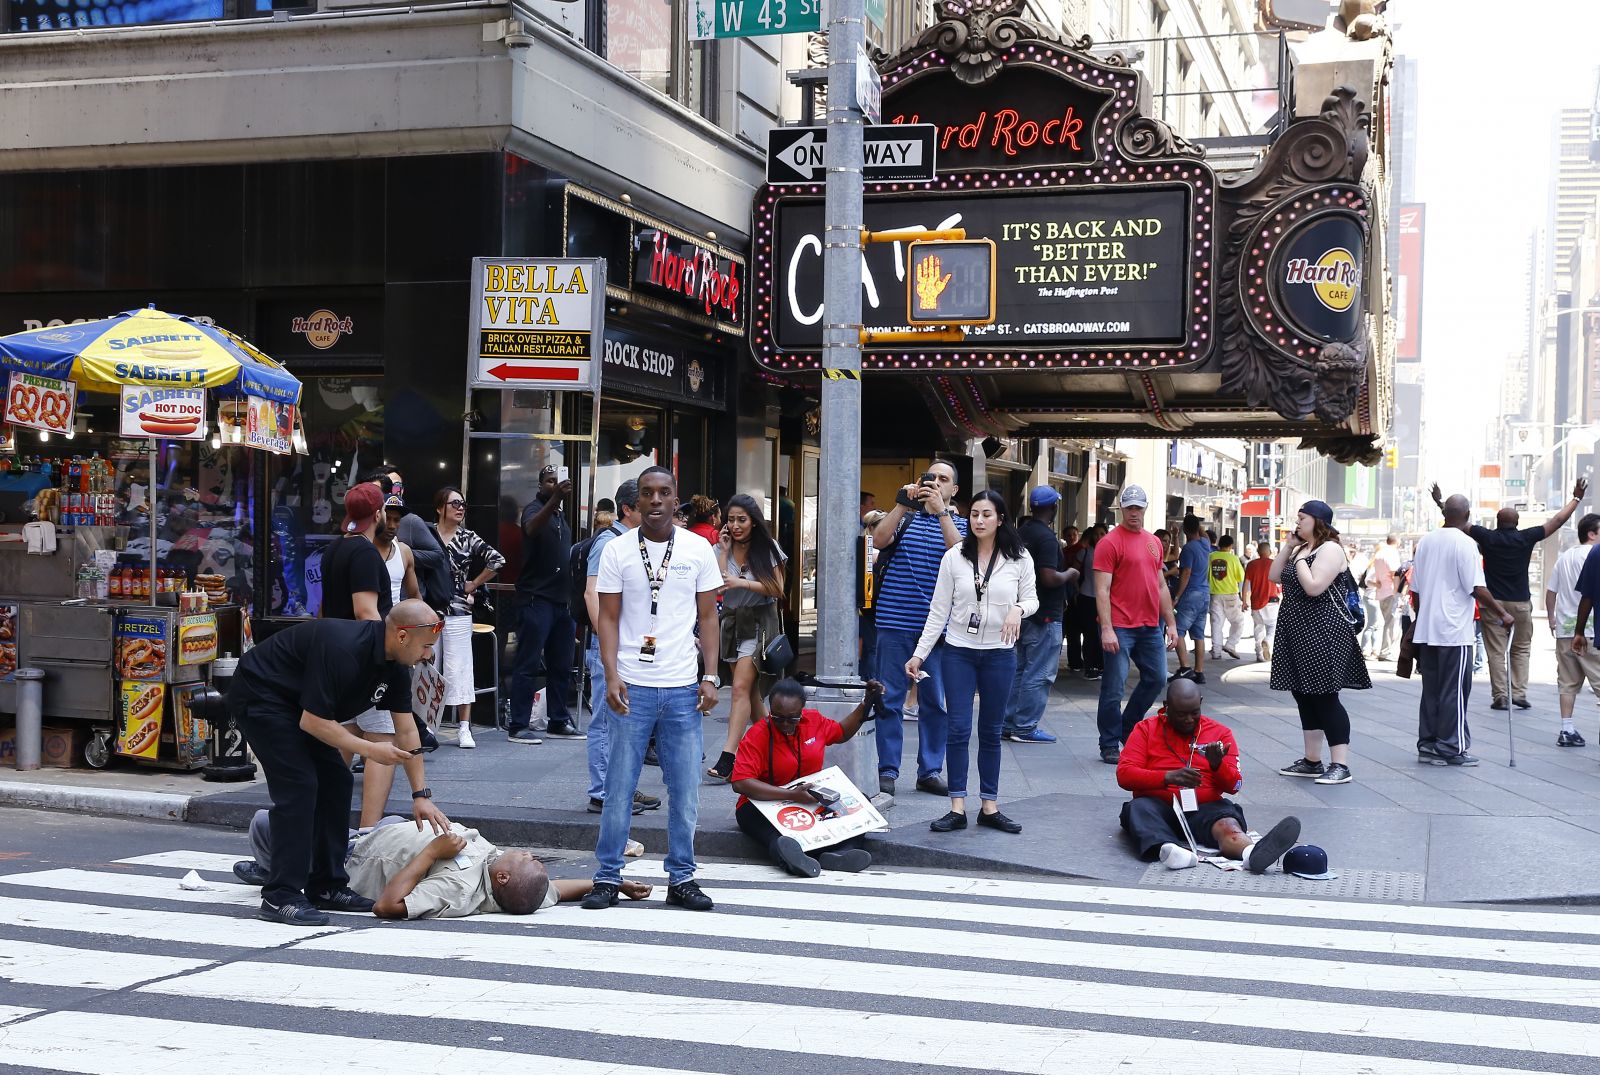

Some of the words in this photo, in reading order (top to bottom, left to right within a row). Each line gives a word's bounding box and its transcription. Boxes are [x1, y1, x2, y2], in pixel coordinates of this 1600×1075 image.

[722, 1, 744, 32] W
[757, 0, 787, 29] 43
[800, 0, 819, 15] St
[991, 107, 1083, 155] Rock
[793, 145, 824, 166] ON
[864, 143, 912, 164] WAY
[1002, 222, 1041, 241] IT’S
[1046, 220, 1106, 240] BACK
[1111, 218, 1162, 237] AND
[1033, 242, 1126, 261] “BETTER
[485, 265, 588, 294] BELLA
[651, 230, 700, 297] Hard
[699, 249, 739, 322] Rock
[1014, 265, 1079, 284] THAN
[1083, 262, 1158, 281] EVER!”
[1286, 258, 1340, 284] Hard
[1038, 287, 1053, 297] The
[1053, 286, 1099, 299] Huffington
[1100, 286, 1118, 296] Post
[1329, 291, 1348, 299] CAFE
[484, 296, 559, 325] VITA
[292, 317, 321, 333] Hard
[323, 316, 353, 334] Rock
[998, 324, 1012, 334] ST.
[1023, 322, 1130, 334] CATSBROADWAY.COM
[108, 335, 202, 350] SABRETT
[488, 333, 515, 343] BRICK
[518, 335, 543, 344] OVEN
[546, 335, 572, 344] PIZZA
[575, 336, 582, 344] &
[484, 344, 521, 353] ITALIAN
[523, 345, 585, 354] RESTAURANT
[604, 339, 639, 369] ROCK
[642, 348, 675, 377] SHOP
[23, 374, 63, 391] PRETZEL
[114, 363, 208, 383] SABRETT
[124, 388, 203, 413] SABRETT
[155, 404, 177, 413] HOT
[180, 404, 202, 414] DOG
[251, 431, 289, 450] Beverage
[213, 728, 242, 757] 12
[783, 811, 813, 829] $29
